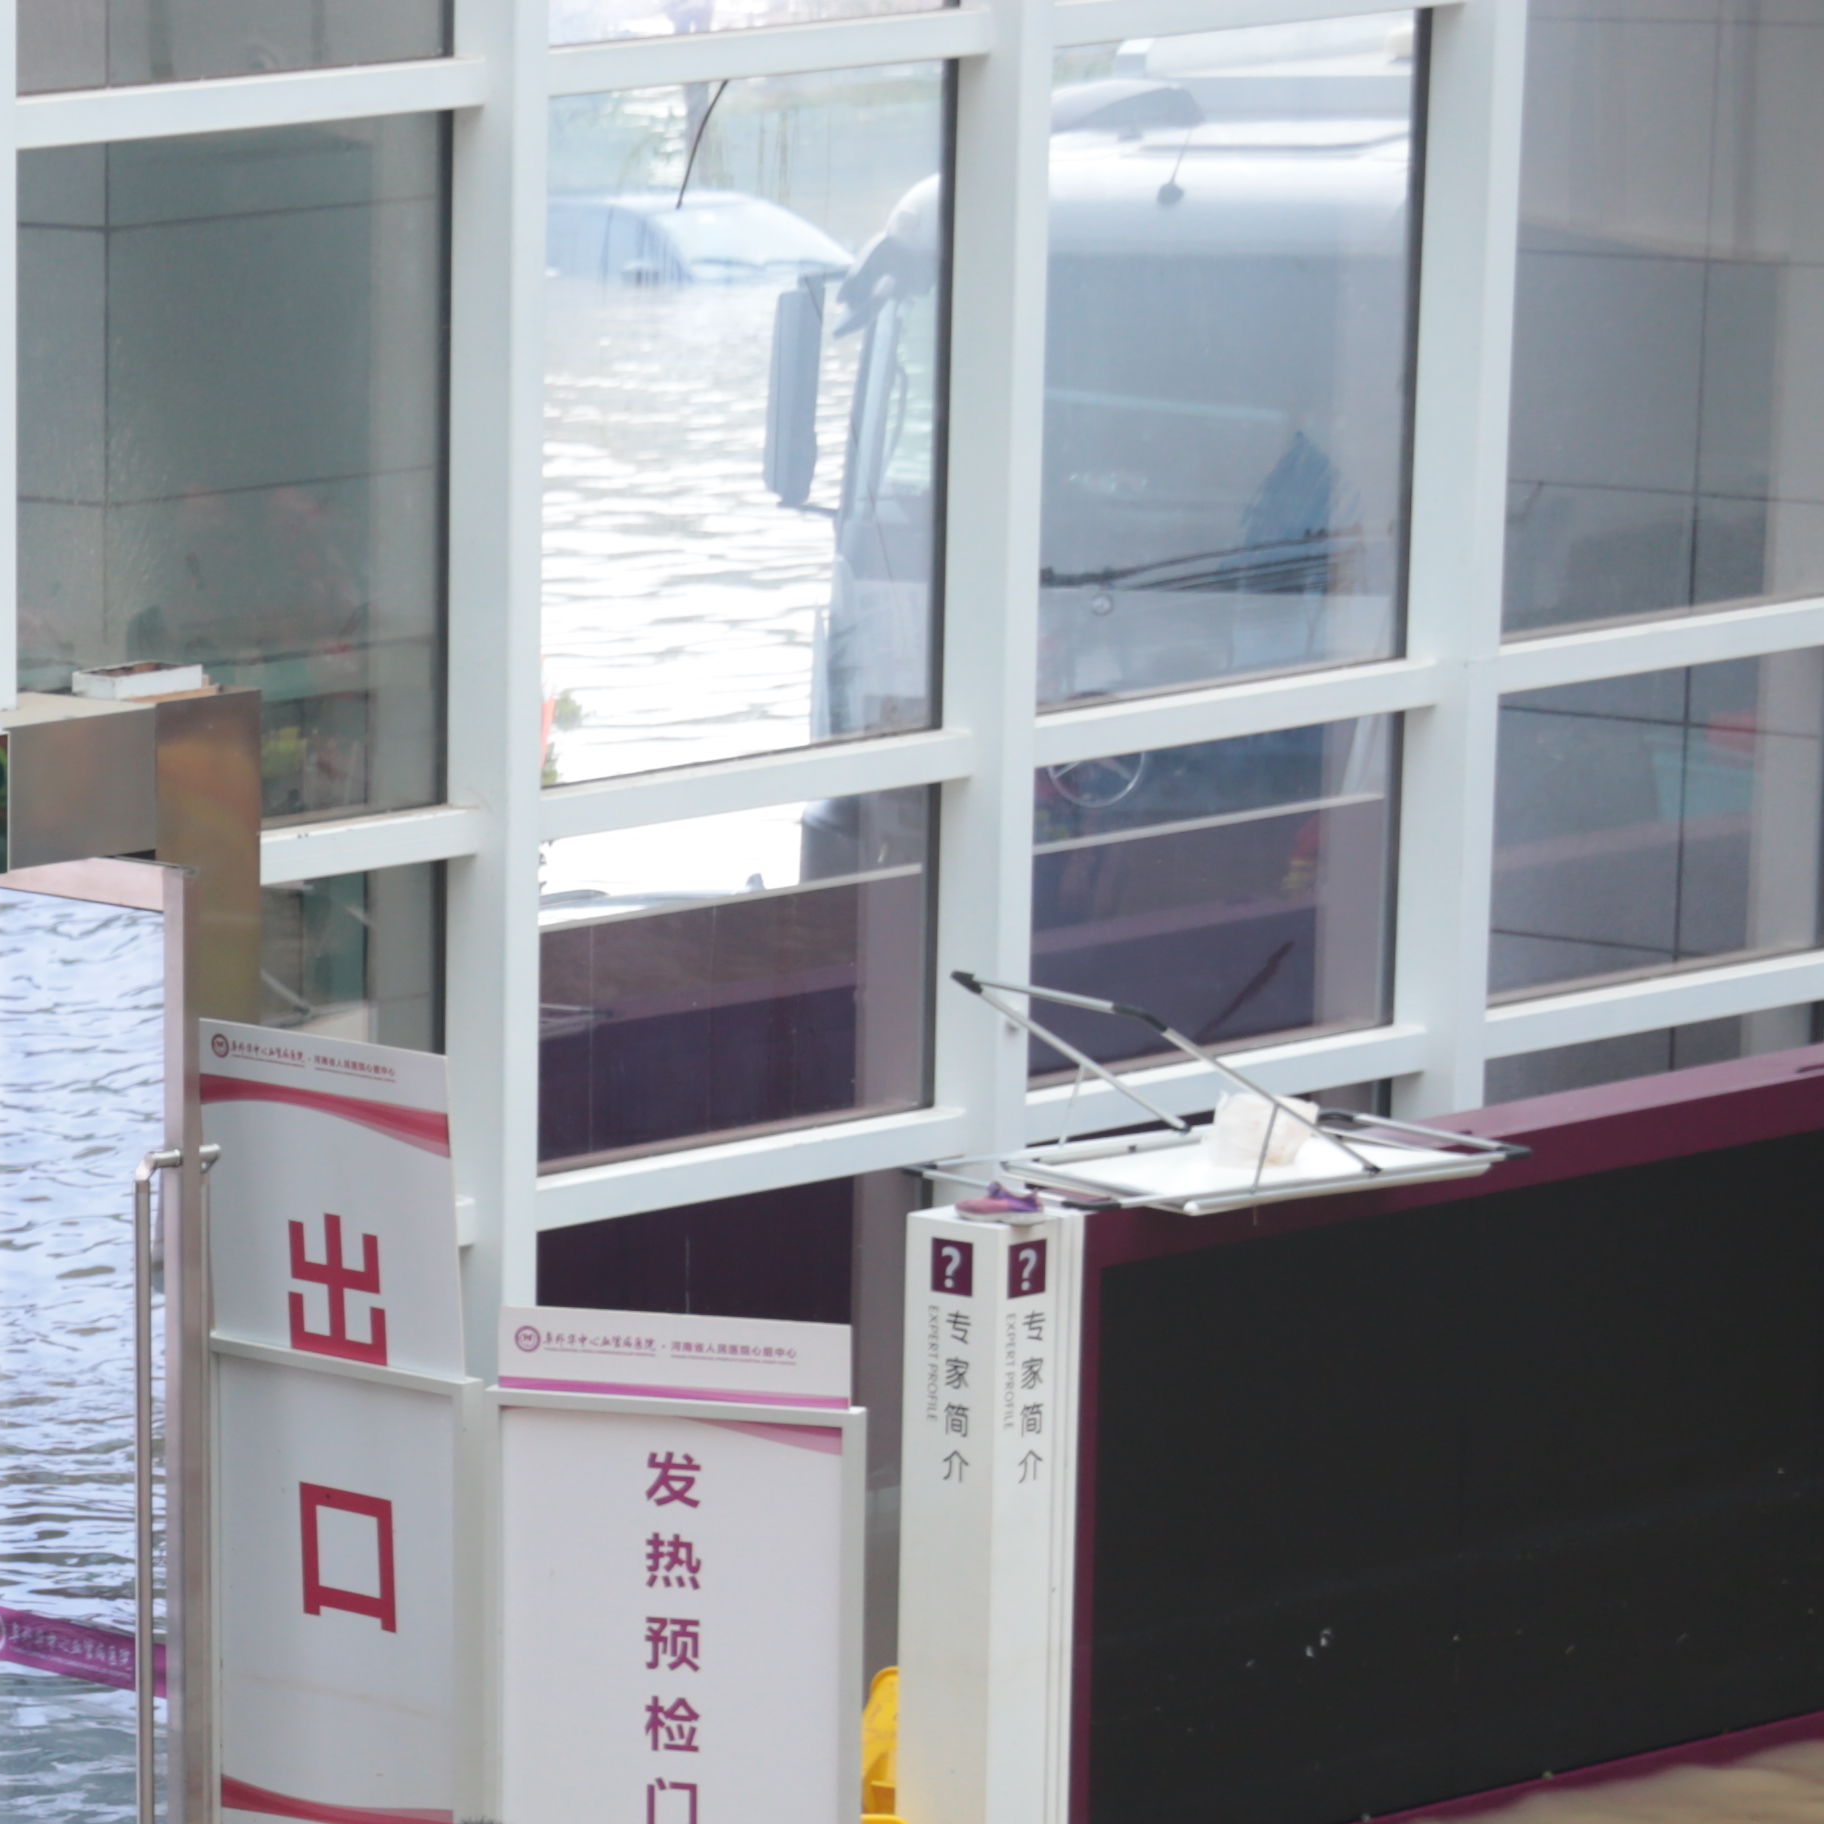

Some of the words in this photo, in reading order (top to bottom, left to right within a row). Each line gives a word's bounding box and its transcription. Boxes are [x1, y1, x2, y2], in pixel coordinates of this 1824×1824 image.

[926, 1304, 940, 1361] EXPERT
[1004, 1313, 1017, 1368] EXPERT
[925, 1363, 939, 1422] PROFILE
[942, 1309, 972, 1484] 专家简介
[1003, 1371, 1016, 1430] PROFILE
[1017, 1309, 1047, 1484] 专家简介
[288, 1213, 398, 1633] 出口
